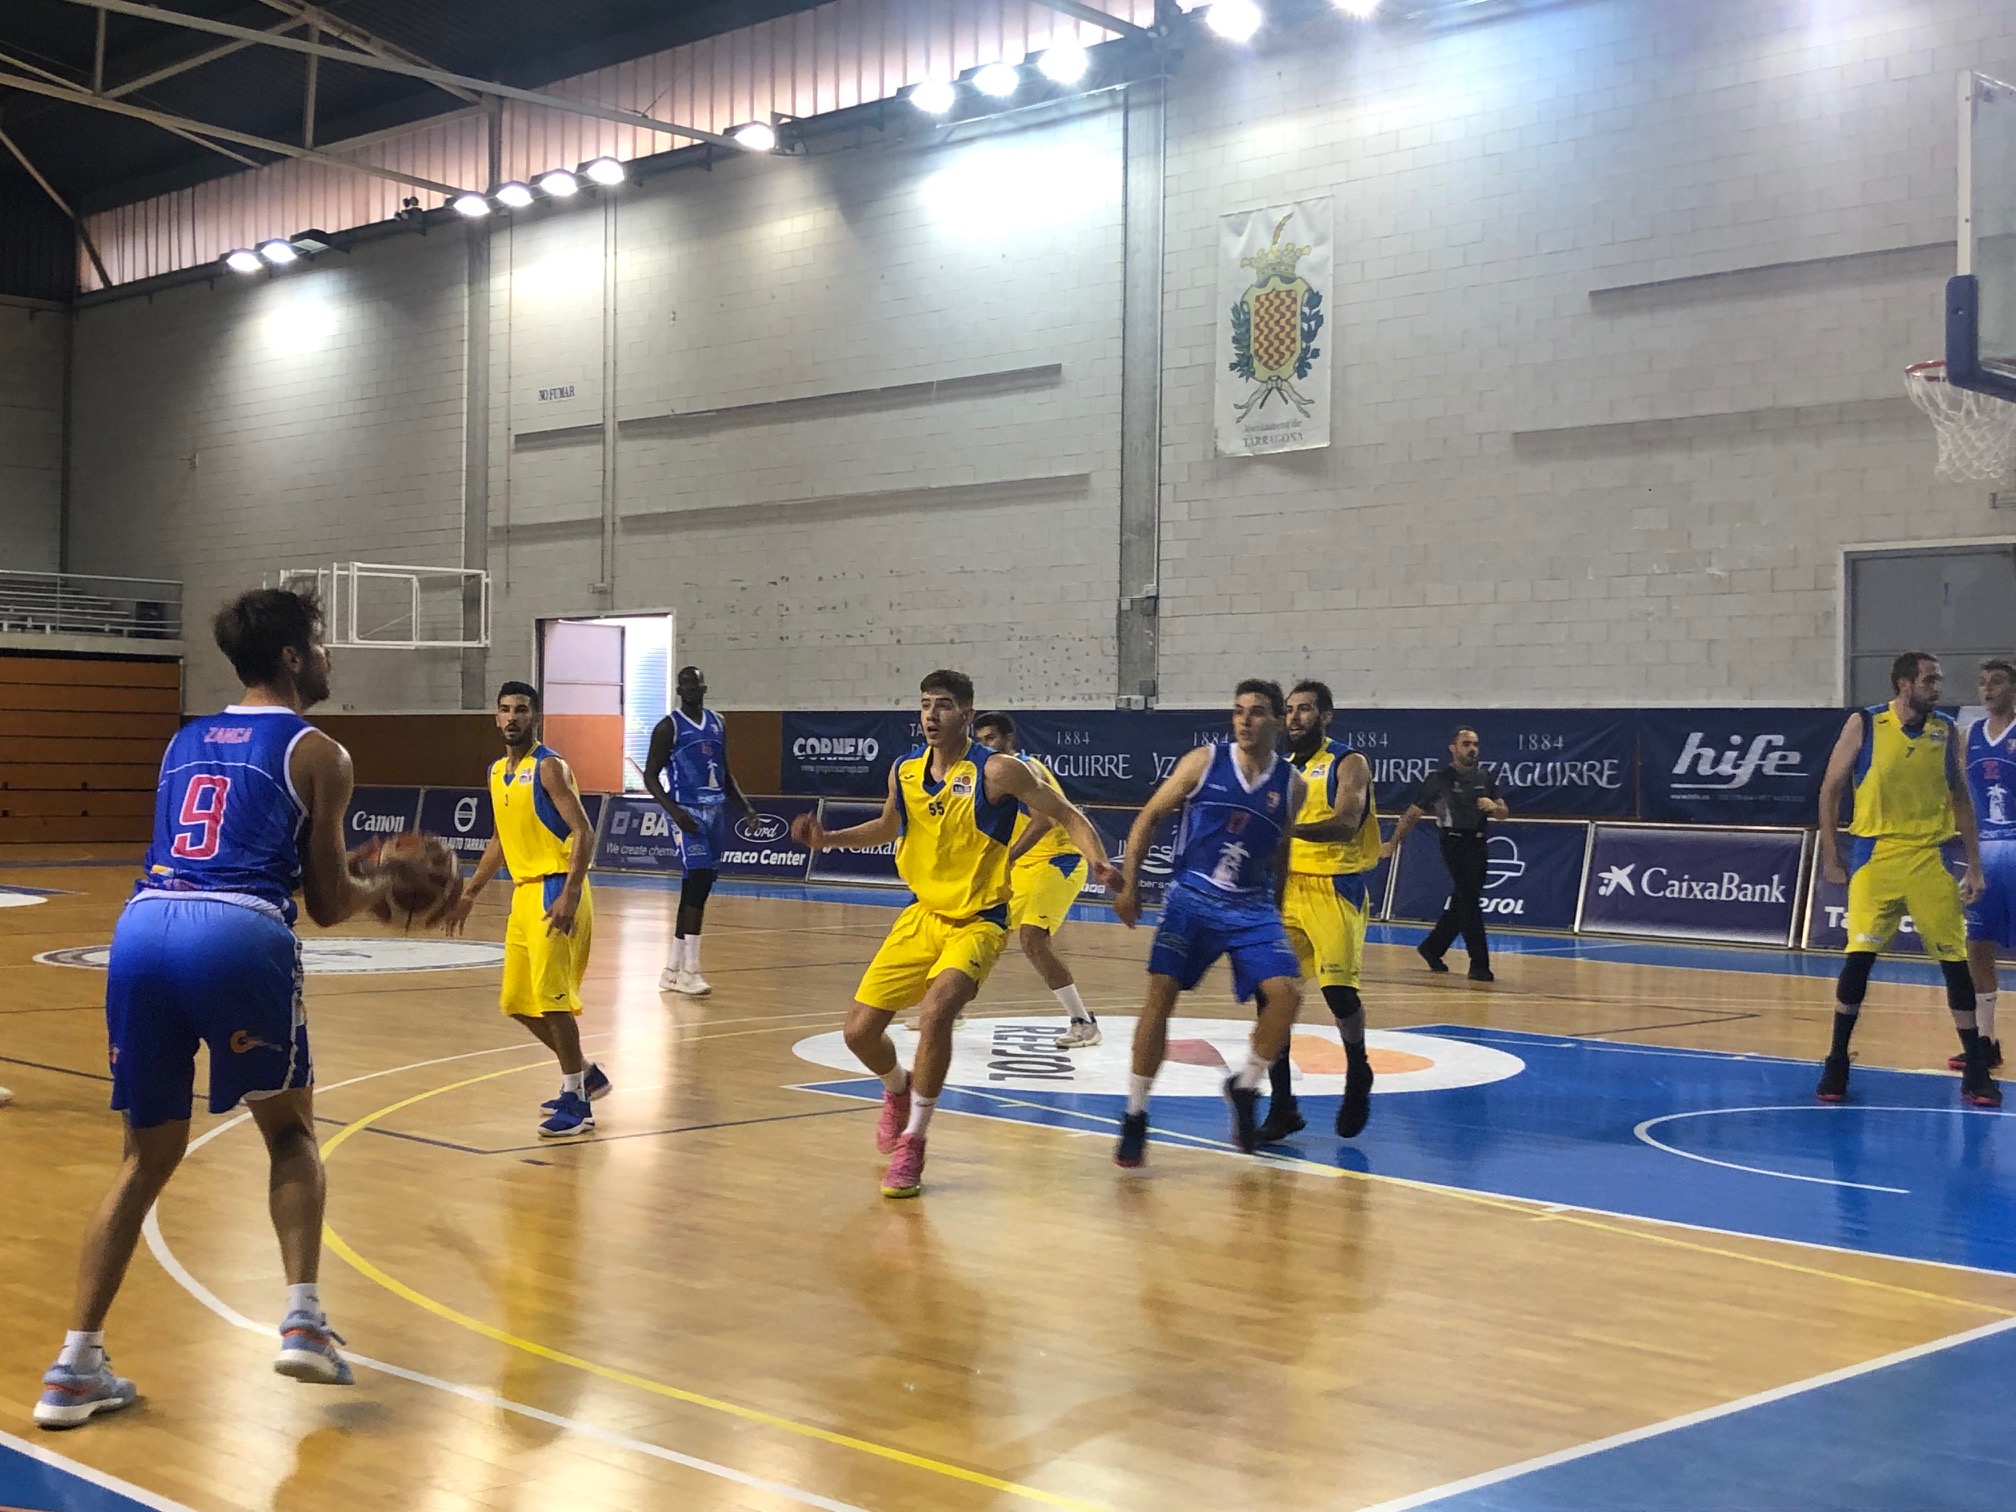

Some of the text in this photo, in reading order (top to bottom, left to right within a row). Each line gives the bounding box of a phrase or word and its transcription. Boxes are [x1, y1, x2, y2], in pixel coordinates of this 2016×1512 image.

[538, 385, 575, 401] NO FUMAR
[1056, 731, 1091, 745] 1884
[1193, 731, 1229, 746] 1884
[1348, 731, 1388, 748] 1884
[1518, 734, 1565, 750] 1884
[792, 737, 879, 761] CORNEJO
[1905, 746, 1916, 759] 7
[1029, 752, 1133, 779] AGUIRRE
[1670, 732, 1808, 789] hife
[929, 801, 945, 816] 55
[170, 774, 231, 861] 9
[352, 811, 405, 833] Canon
[639, 812, 669, 836] BA
[606, 843, 620, 854] We
[621, 845, 648, 856] create
[721, 850, 806, 866] rraco Center
[1641, 867, 1786, 903] CaixaBank
[986, 1025, 1076, 1081] REPSOL
